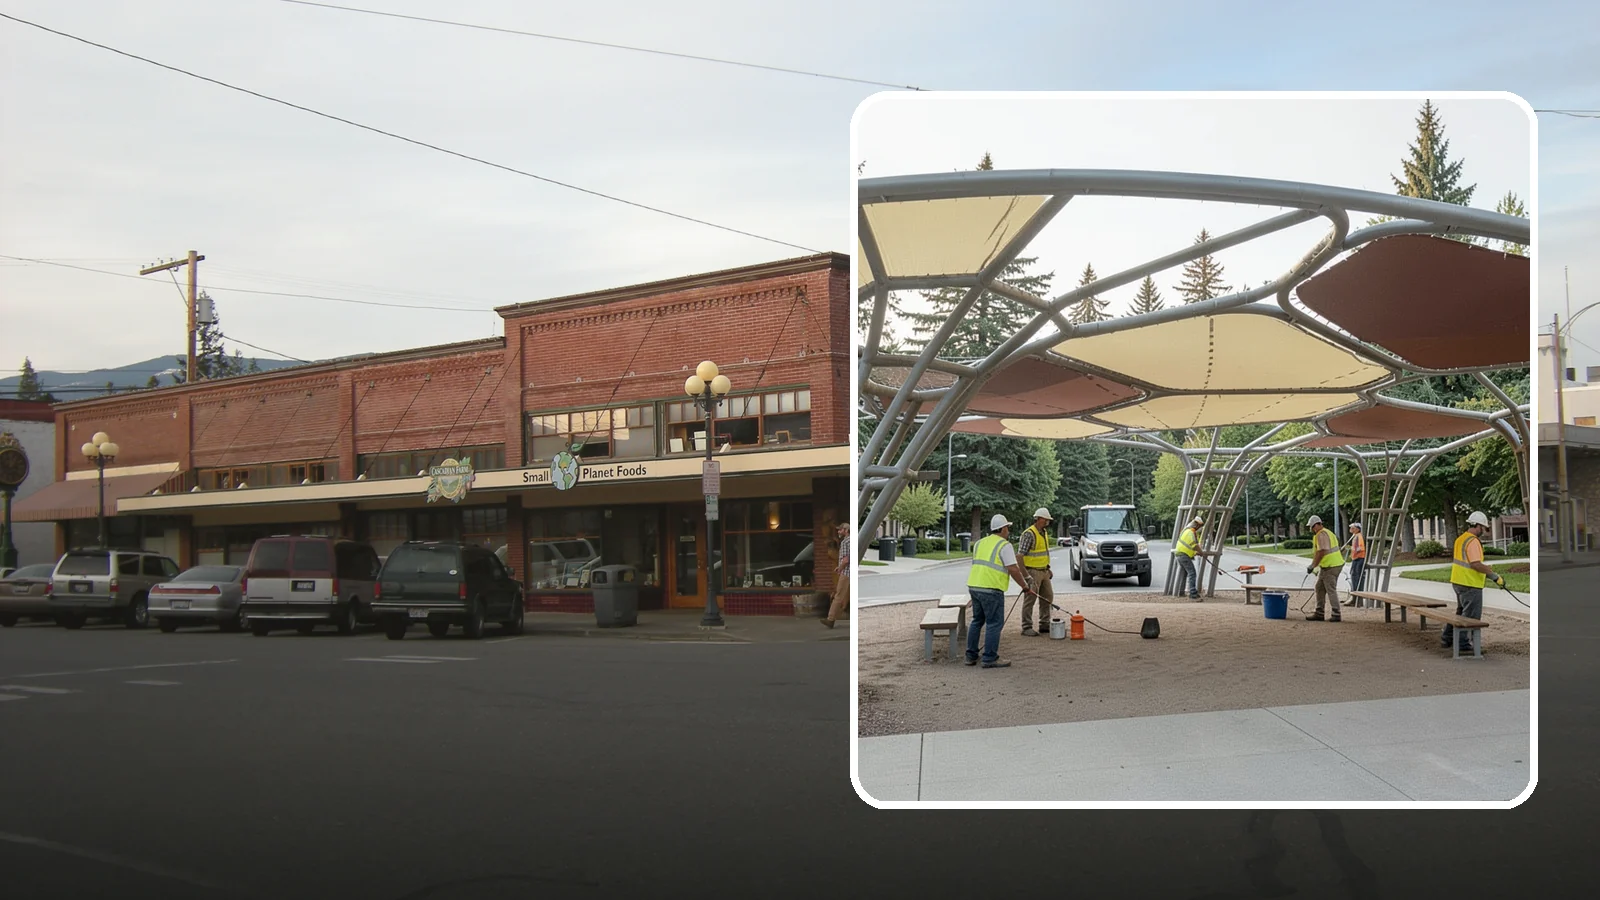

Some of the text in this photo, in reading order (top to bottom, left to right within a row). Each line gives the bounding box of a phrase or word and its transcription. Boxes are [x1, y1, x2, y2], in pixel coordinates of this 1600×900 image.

[523, 464, 647, 483] Small Planet Foods
